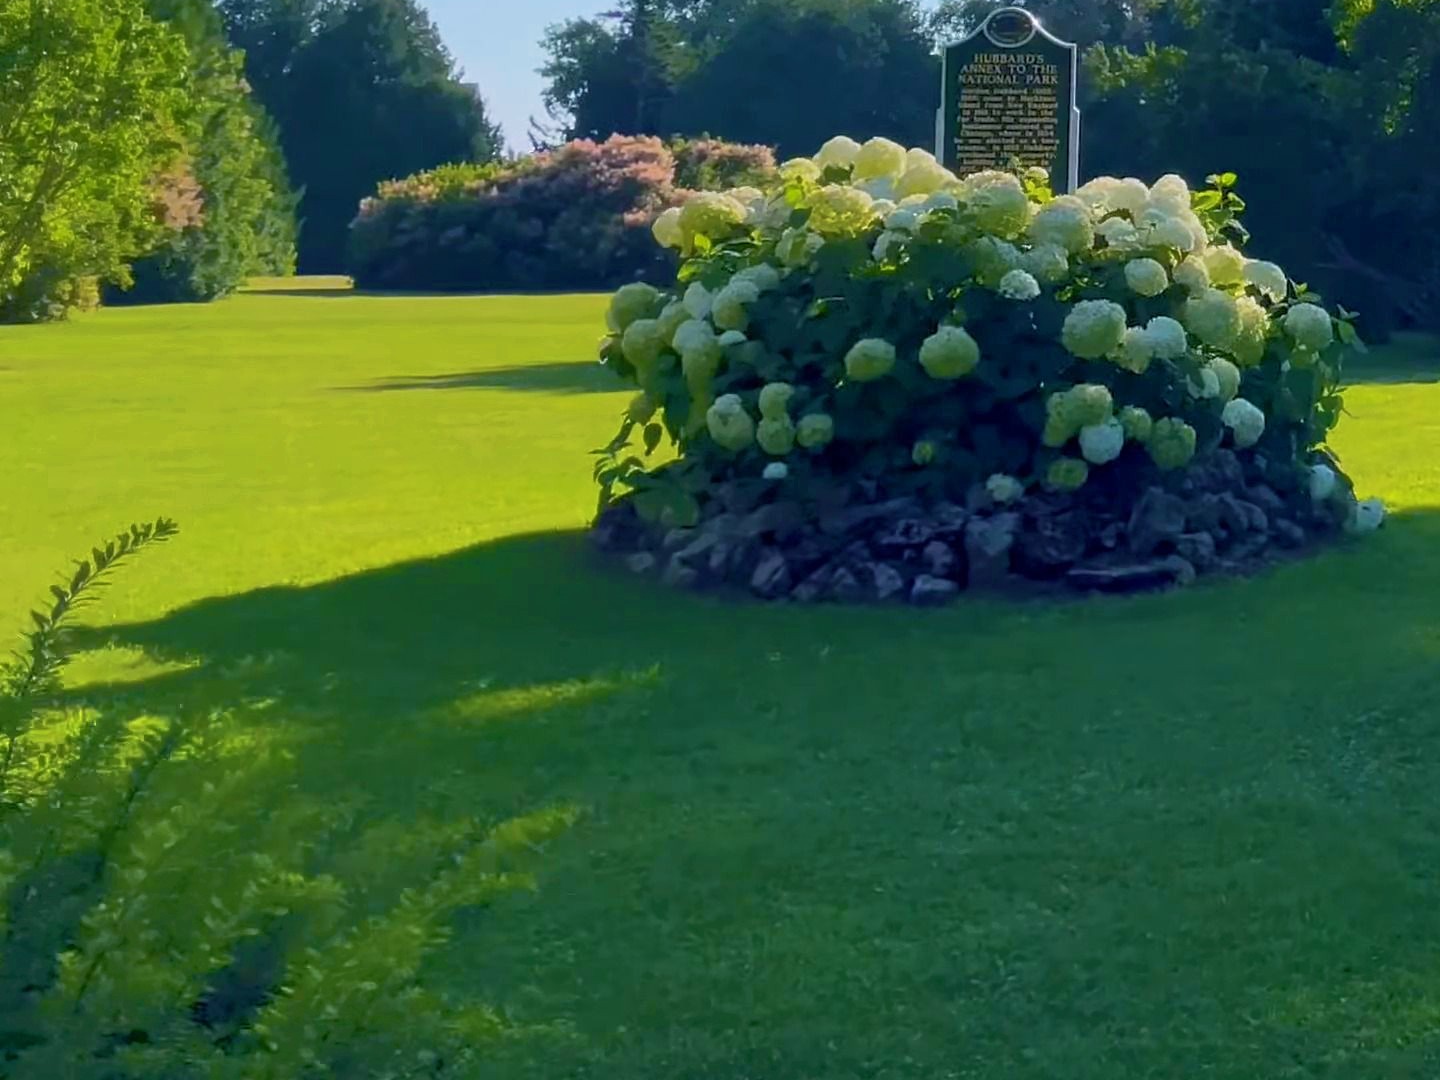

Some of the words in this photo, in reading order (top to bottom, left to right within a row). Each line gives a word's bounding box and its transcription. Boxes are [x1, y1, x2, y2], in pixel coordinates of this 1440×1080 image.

[960, 64, 1002, 74] ANNEX
[1007, 64, 1026, 74] TO
[1031, 64, 1057, 74] THE
[958, 74, 1019, 84] NATIONAL
[1026, 74, 1058, 84] PARK
